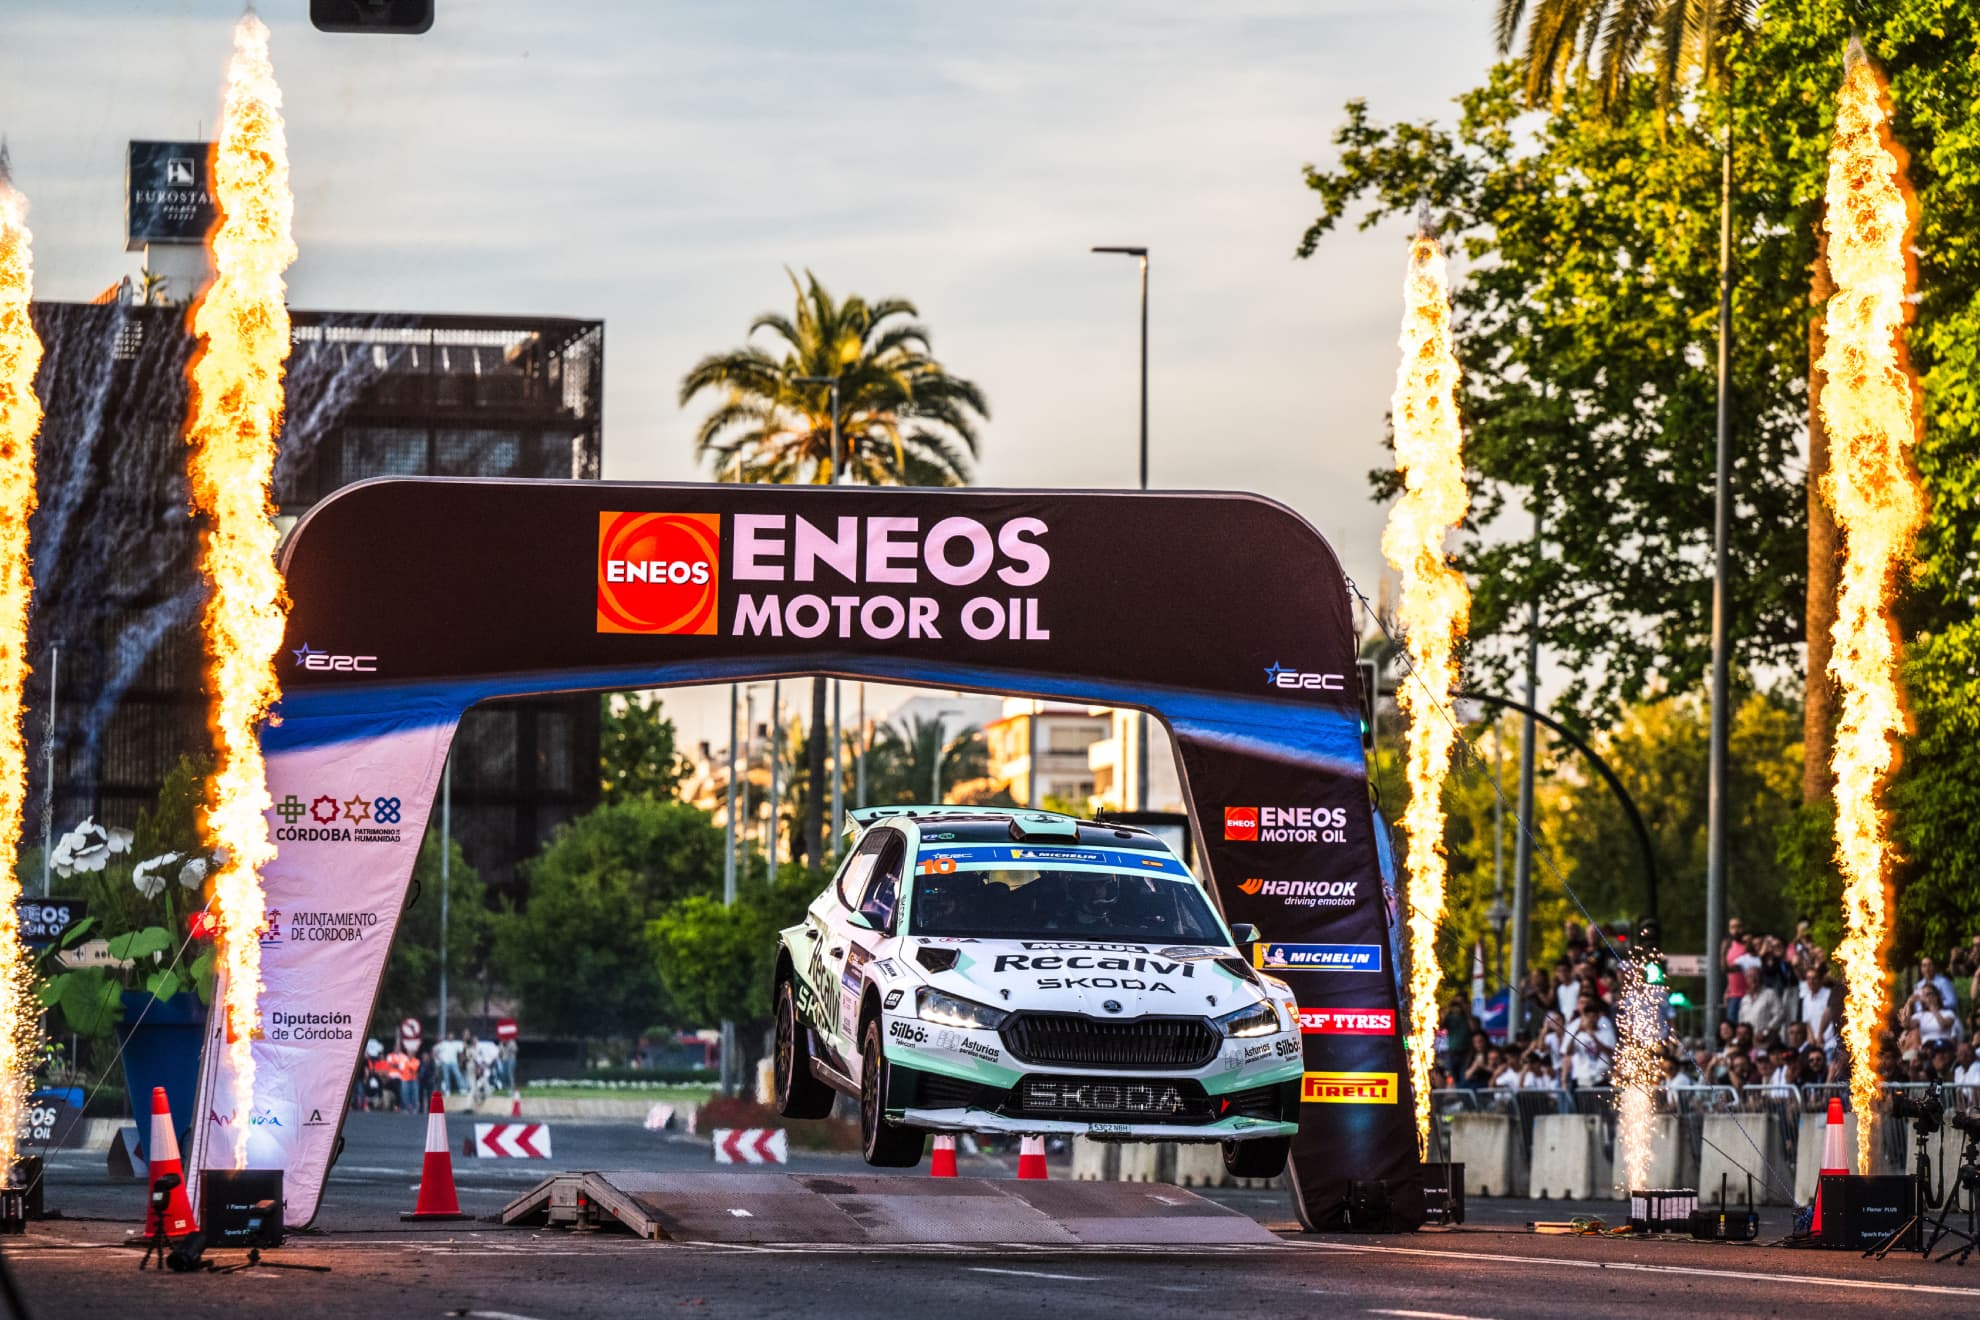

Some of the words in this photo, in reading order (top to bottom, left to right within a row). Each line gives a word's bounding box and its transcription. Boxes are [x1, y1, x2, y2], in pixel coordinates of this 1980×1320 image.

[731, 512, 1051, 587] ENEOS
[606, 559, 710, 586] ENEOS
[731, 593, 943, 640] MOTOR
[960, 596, 1051, 641] OIL
[305, 654, 378, 672] ERC
[1276, 672, 1345, 690] ERC
[1227, 819, 1256, 828] ENEOS
[1260, 806, 1348, 829] ENEOS
[276, 826, 352, 842] CÓRDOBA
[1260, 829, 1318, 842] MOTOR
[1321, 829, 1348, 843] OIL
[1038, 852, 1098, 860] MICHELIN
[918, 858, 958, 875] 10
[1284, 896, 1317, 908] driving
[1317, 896, 1356, 906] emotion
[291, 912, 378, 926] AYUNTAMIENTO
[291, 927, 306, 941] DE
[1028, 942, 1147, 954] MOTUL
[993, 954, 1195, 978] Recalvi
[1289, 952, 1371, 964] MICHELIN
[272, 1011, 352, 1027] Diputación
[1299, 1013, 1330, 1028] RF
[1332, 1014, 1392, 1029] TYRES
[271, 1027, 289, 1040] de
[293, 1027, 353, 1040] Córdoba
[960, 1036, 1001, 1058] Asturias
[1304, 1077, 1389, 1098] PIRELLI
